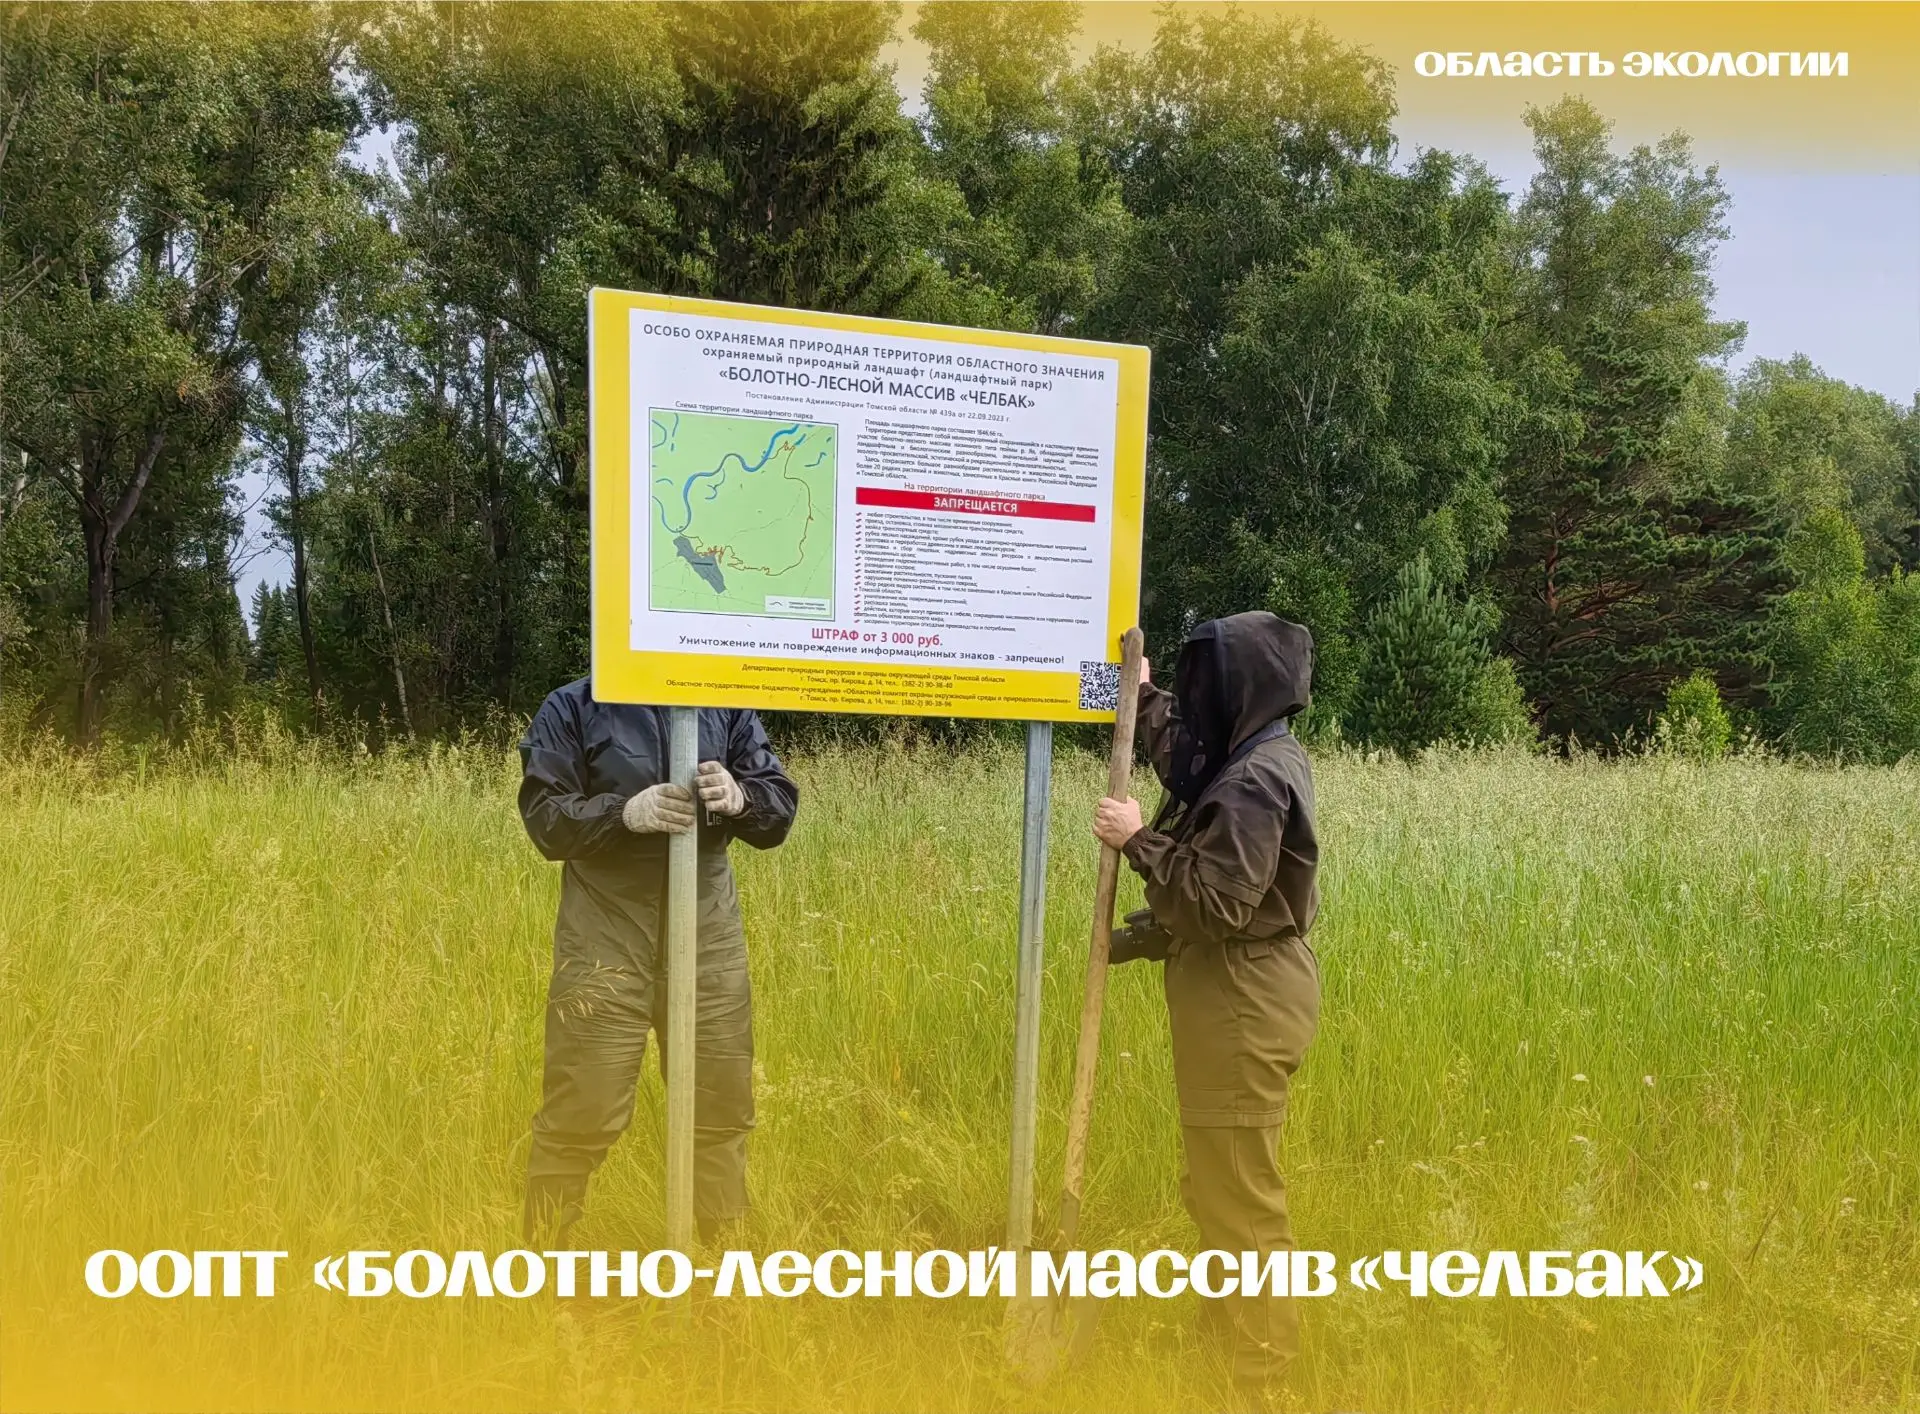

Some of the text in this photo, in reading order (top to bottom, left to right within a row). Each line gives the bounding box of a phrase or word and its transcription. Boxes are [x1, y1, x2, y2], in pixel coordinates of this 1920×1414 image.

[644, 324, 1104, 380] ОСОБО ОХРАНЯЕМАЯ ПРИРОДНАЯ ТЕРРИТОРИЯ ОБЛАСТНОГО ЗНАЧЕНИЯ
[702, 348, 1052, 391] охраняемый природный ландшафт (ландшафтный парк)
[719, 366, 1035, 409] «БОЛОТНО-ЛЕСНОЙ МАССИВ «ЧЕЛБАК»
[675, 400, 813, 421] Схема территории ландшафтного парка
[745, 391, 804, 403] Постановление
[805, 397, 864, 408] Администрации
[866, 402, 897, 411] Томской
[899, 406, 927, 414] области
[904, 482, 1046, 501] На территории ландшафтного парка
[934, 497, 1017, 512] ЗАПРЕЩАЕТСЯ
[679, 635, 756, 648] Уничтожение
[783, 643, 857, 653] повреждение
[861, 646, 957, 658] информационных
[960, 652, 995, 661] знаков
[1005, 655, 1064, 664] запрещено!
[812, 628, 943, 648] ШТРАФ от 3 000 руб.
